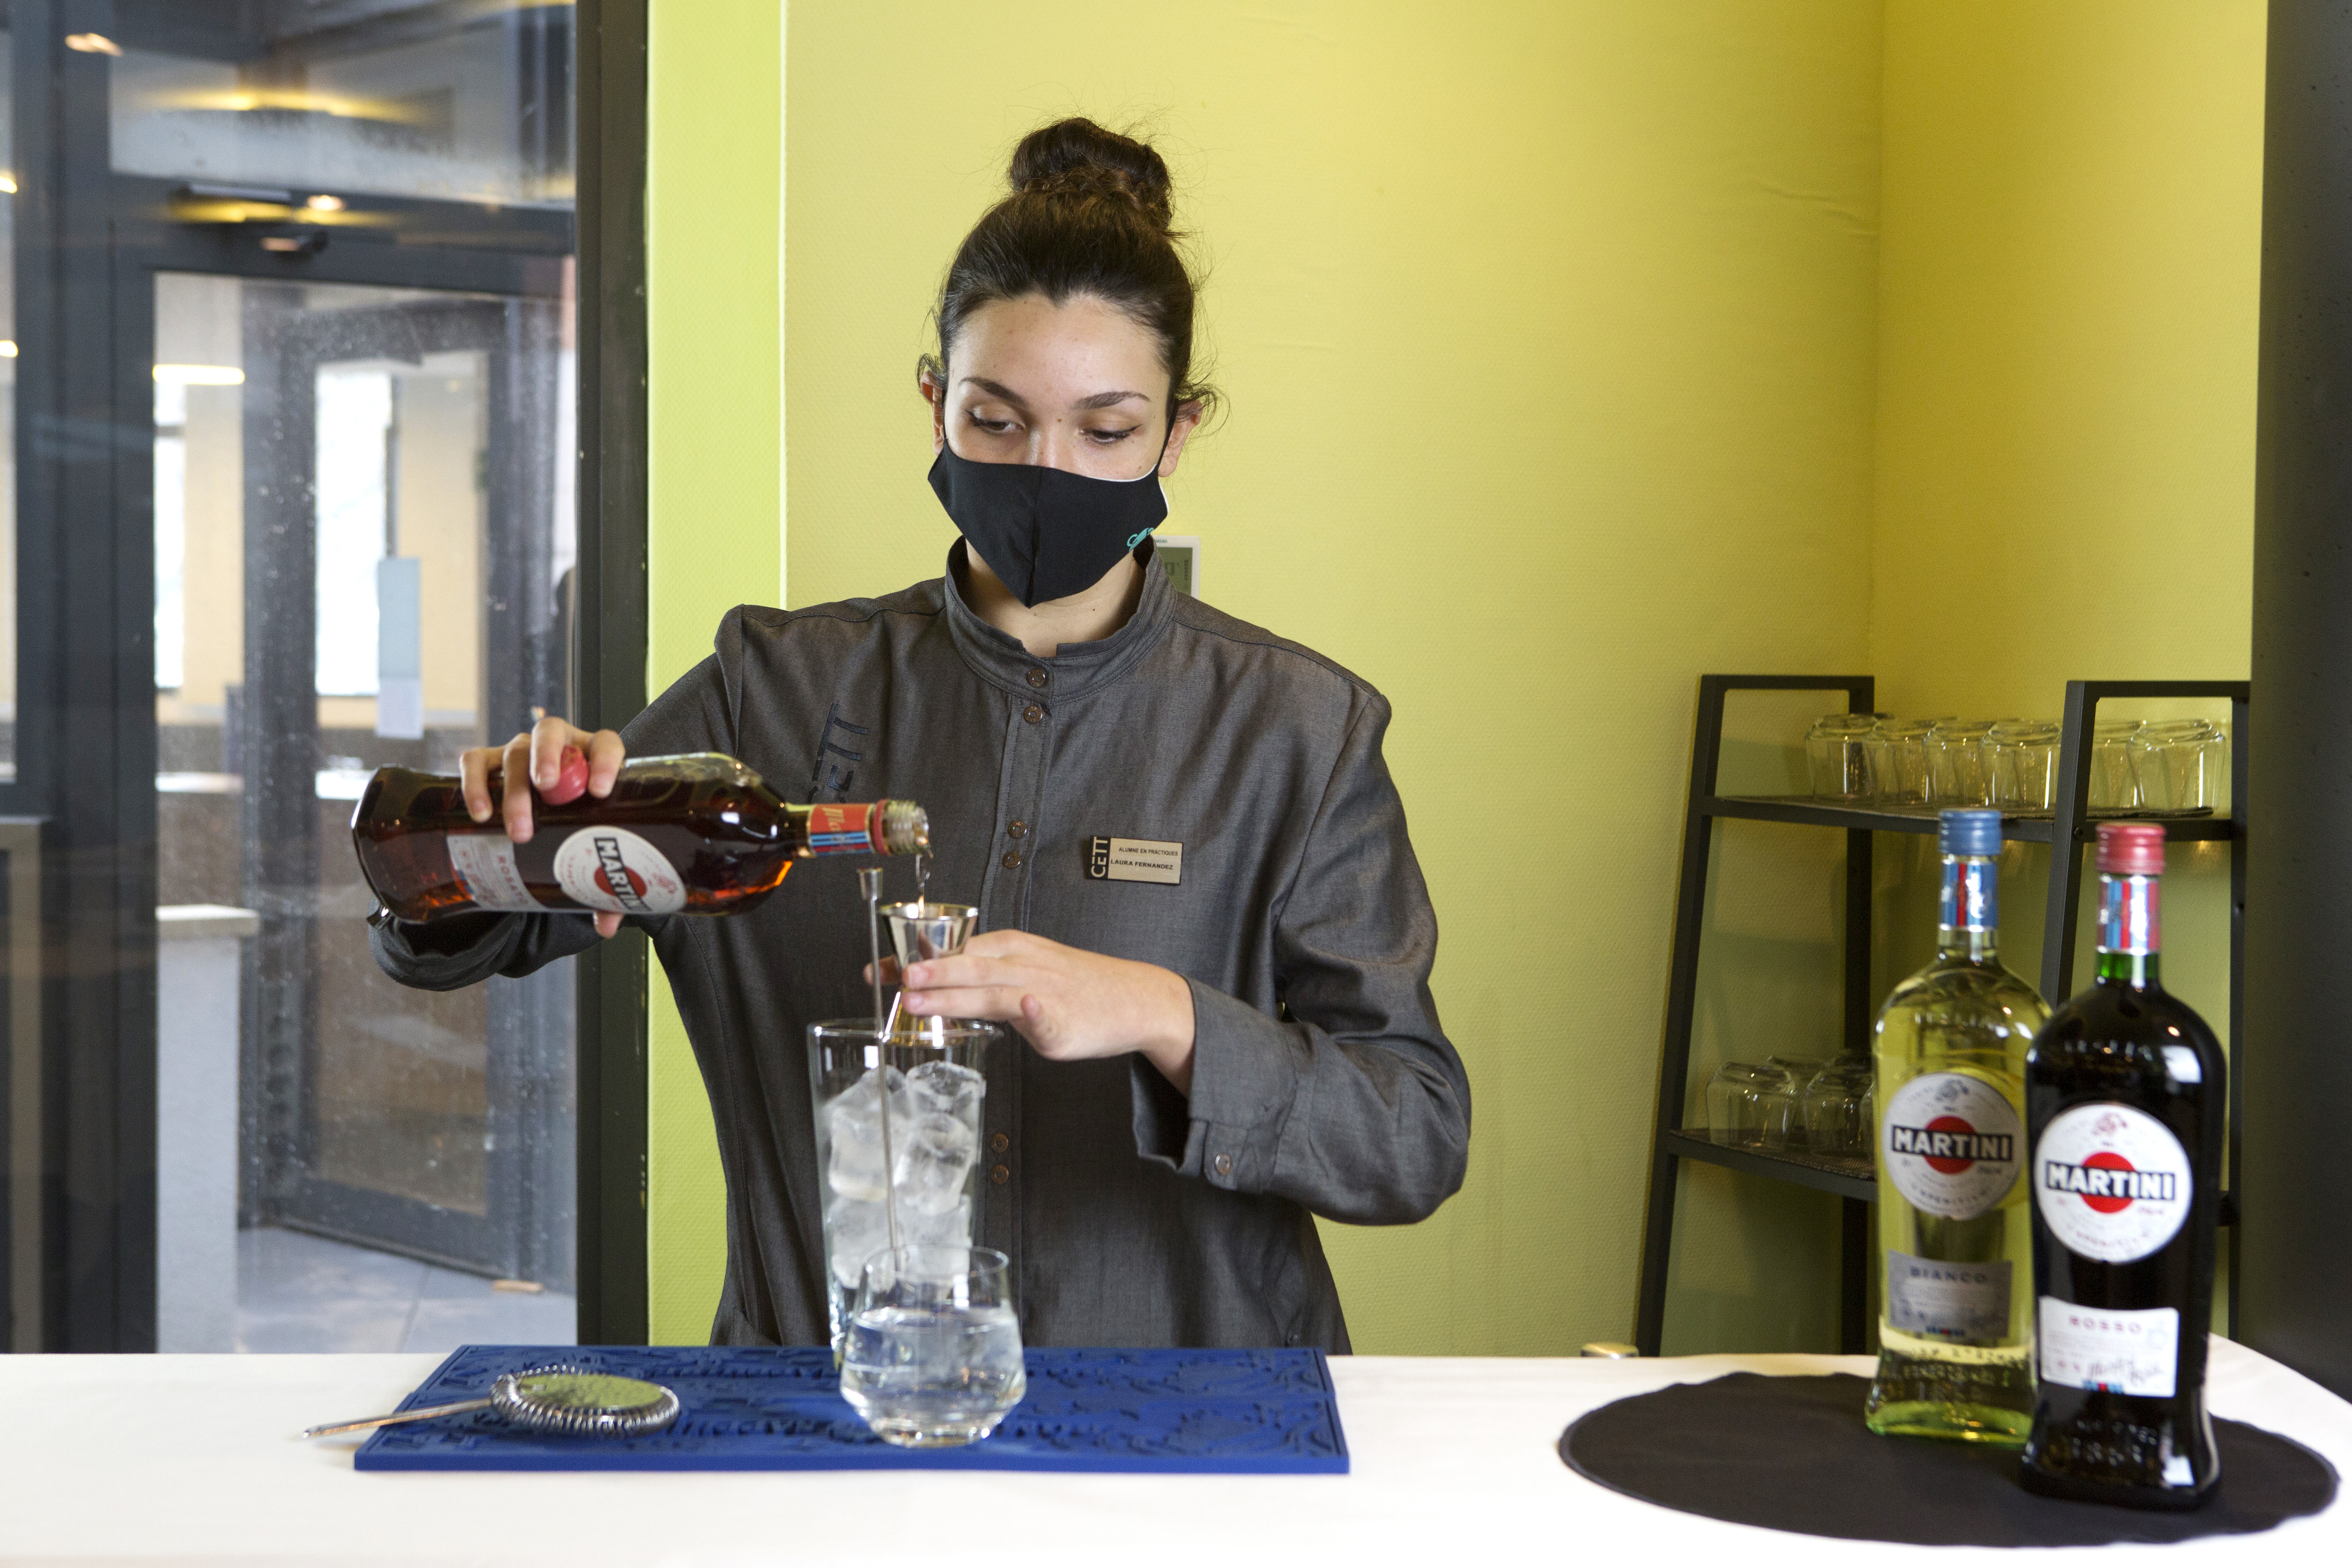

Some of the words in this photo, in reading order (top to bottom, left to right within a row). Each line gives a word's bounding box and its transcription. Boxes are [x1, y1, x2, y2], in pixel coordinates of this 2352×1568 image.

[595, 839, 644, 908] MARTIN
[1091, 837, 1108, 878] CETT
[1134, 861, 1174, 870] FERNANDEZ
[1894, 1127, 2009, 1159] MARTINI
[2048, 1164, 2174, 1200] MARTINI
[1910, 1265, 1988, 1283] BIANCO
[2069, 1315, 2142, 1335] ROSSO
